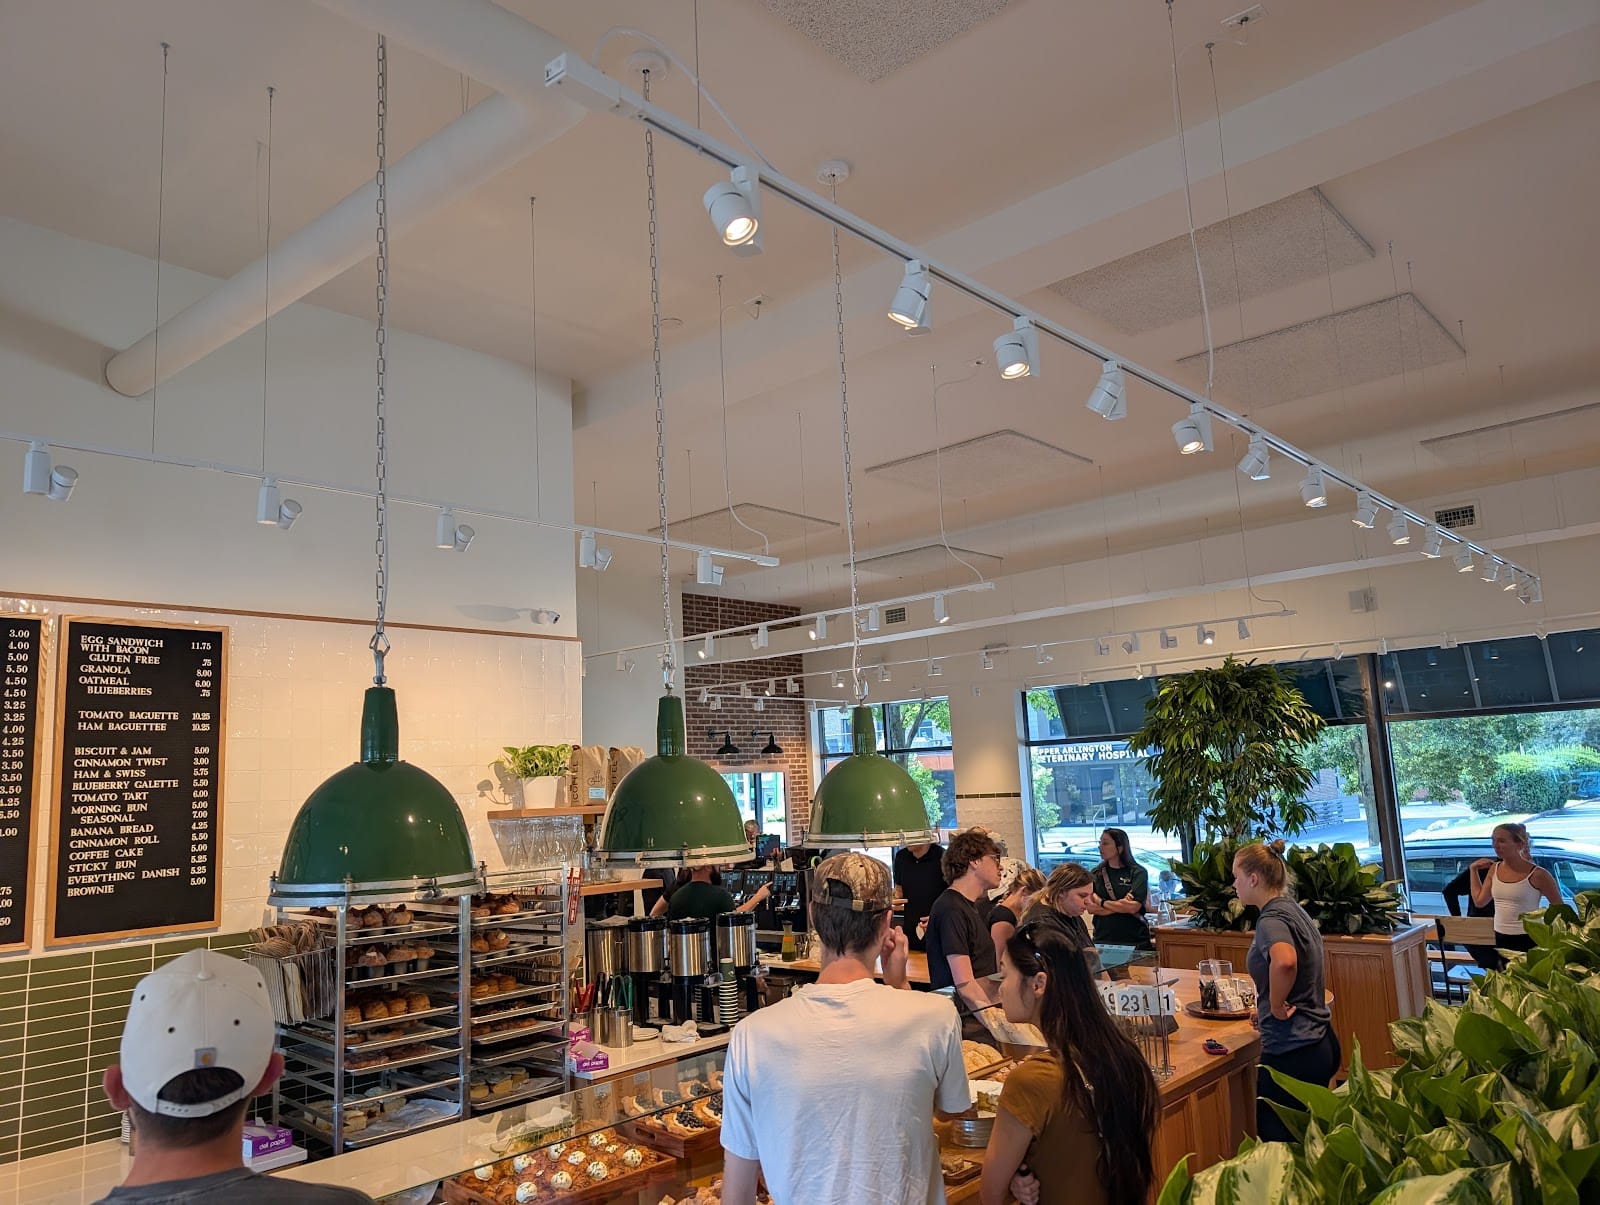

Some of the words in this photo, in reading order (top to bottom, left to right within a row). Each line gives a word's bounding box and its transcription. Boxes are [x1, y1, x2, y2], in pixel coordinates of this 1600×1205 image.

[9, 630, 30, 638] 3.00
[8, 642, 30, 650] 4.00
[80, 635, 104, 644] EGG
[107, 637, 164, 648] SANDWICH
[191, 642, 211, 650] 11.75
[81, 644, 110, 653] WITH
[116, 645, 150, 655] BACON
[7, 653, 29, 662] 5.00
[89, 654, 131, 663] GLUTEN
[135, 655, 160, 665] FREE
[6, 665, 28, 674] 5.50
[80, 665, 131, 675] GRANOLA
[4, 677, 27, 686] 4.50
[78, 676, 129, 686] OATMEAL
[195, 680, 211, 688] 6.00
[3, 689, 27, 697] 4.50
[87, 686, 152, 696] BLUEBERRIES
[3, 701, 26, 710] 3.25
[3, 713, 26, 722] 3.25
[78, 710, 124, 720] TOMATO
[129, 711, 179, 721] BAGUETTE
[2, 726, 25, 734] 4.00
[77, 722, 103, 731] HAM
[1, 737, 25, 746] 4.25
[2, 749, 24, 758] 3.50
[74, 746, 118, 756] BISCUIT
[120, 747, 127, 756] &
[131, 747, 152, 756] JAM
[1034, 747, 1060, 755] PPER
[1062, 744, 1113, 754] ARLINGTON
[74, 758, 131, 768] CINNAMON
[136, 758, 168, 766] TWIST
[1036, 752, 1095, 763] ETERINARY
[1, 761, 23, 770] 3.50
[1, 773, 22, 782] 3.50
[74, 770, 99, 779] HAM
[103, 770, 111, 778] &
[115, 769, 146, 778] SWISS
[193, 768, 209, 776] 5.75
[72, 781, 130, 791] BLUEBERRY
[134, 780, 179, 789] GALETTE
[193, 779, 208, 787] 5.50
[72, 793, 117, 803] TOMATO
[122, 791, 149, 801] TART
[71, 804, 121, 815] MORNING
[127, 803, 148, 813] BUN
[192, 801, 208, 809] 5.00
[80, 814, 135, 824] SEASONAL
[192, 811, 208, 819] 7.00
[70, 826, 114, 837] BANANA
[120, 824, 154, 834] BREAD
[69, 837, 128, 849] CINNAMON
[134, 836, 160, 845] ROLL
[191, 833, 208, 841] 5.50
[69, 850, 109, 861] COFFEE
[115, 848, 144, 858] CAKE
[191, 844, 208, 853] 5.00
[68, 862, 109, 873] STICKY
[115, 860, 137, 870] BUN
[67, 872, 135, 885] EVERYTHING
[142, 868, 180, 880] DANISH
[67, 885, 115, 897] BROWNIE
[190, 877, 207, 886] 5.00
[1120, 994, 1140, 1012] 23
